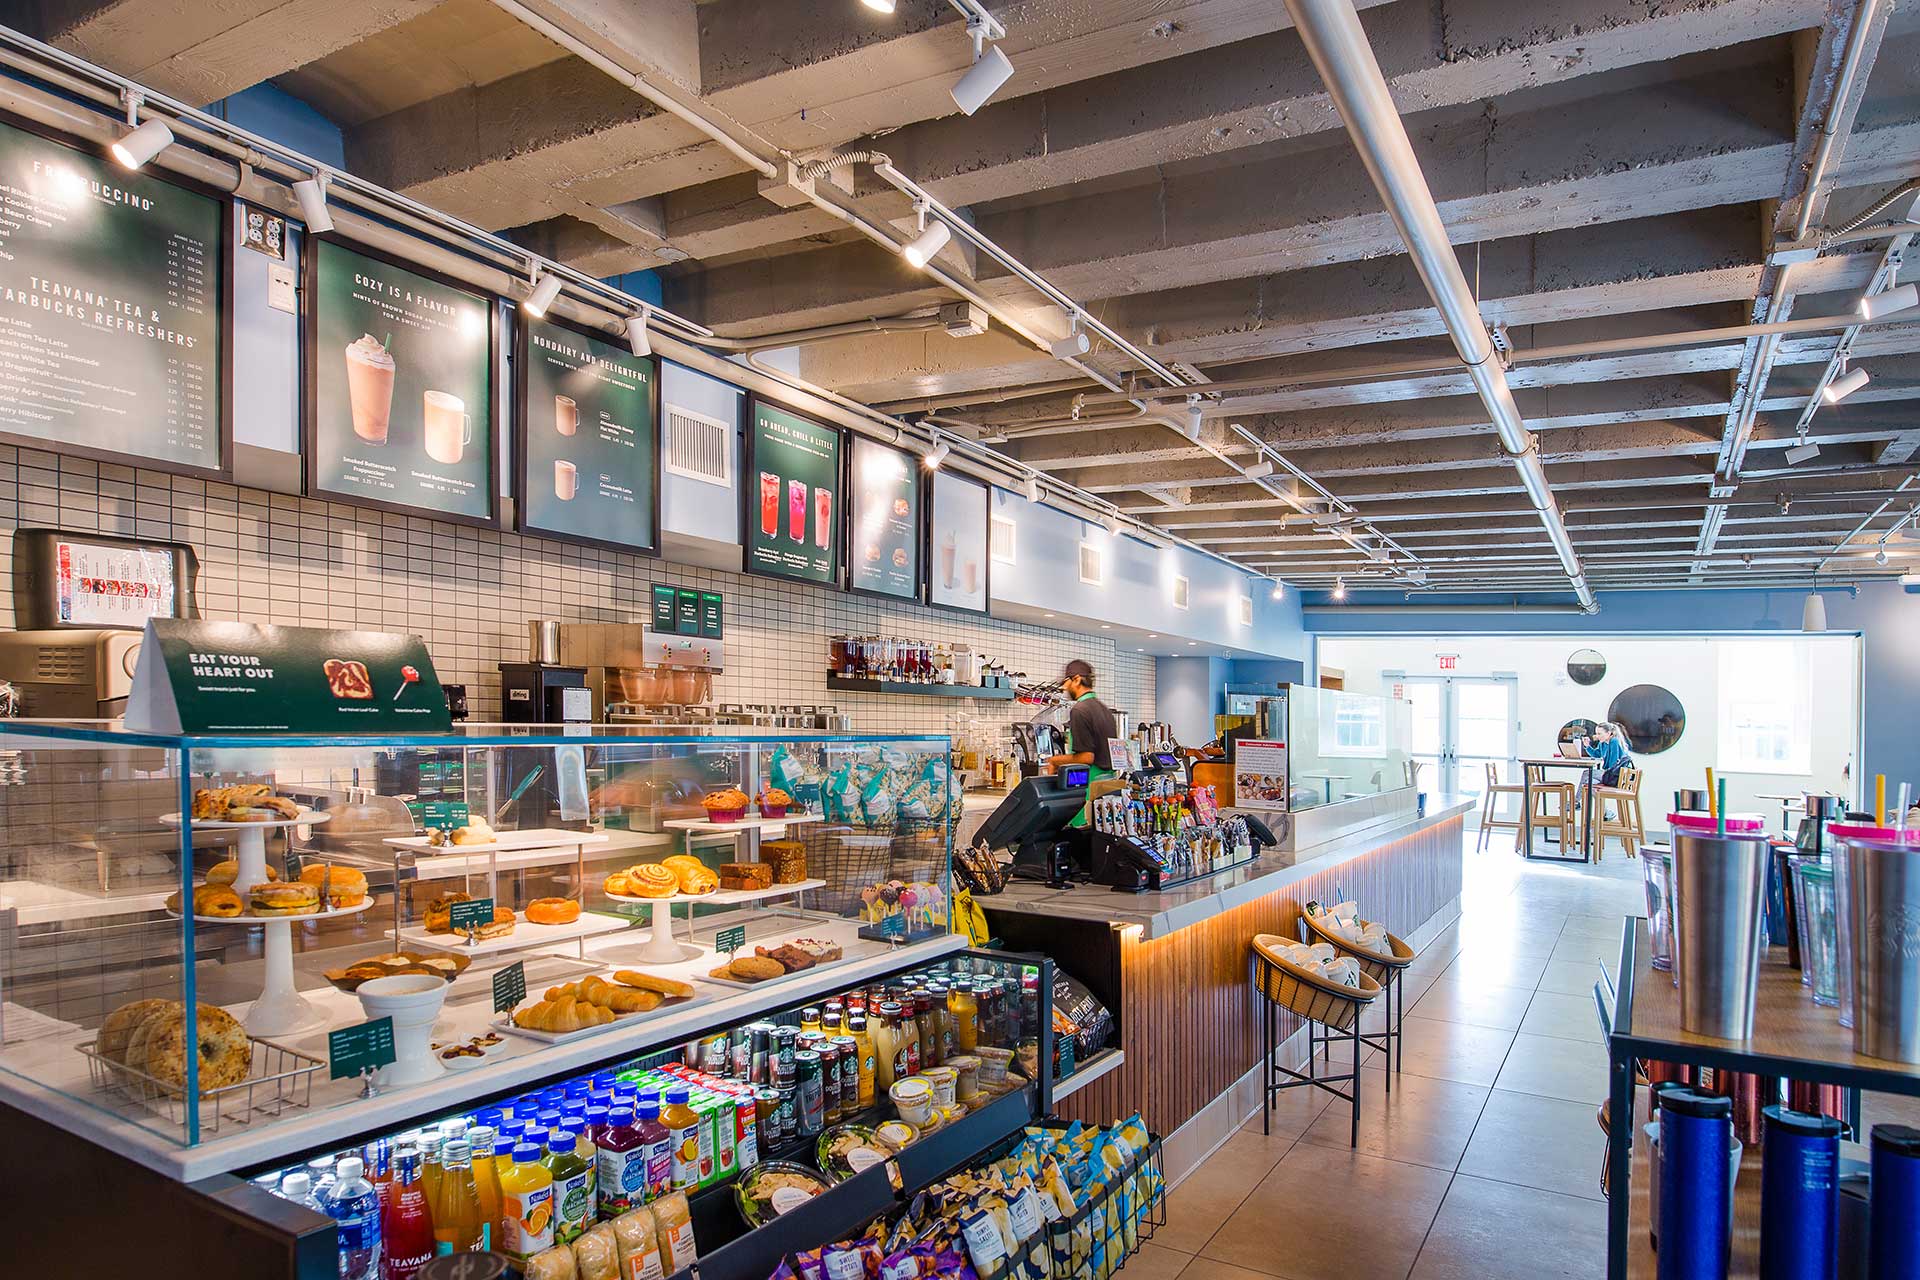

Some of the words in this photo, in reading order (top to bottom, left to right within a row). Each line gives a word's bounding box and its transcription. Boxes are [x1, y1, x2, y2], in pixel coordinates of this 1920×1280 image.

[34, 161, 154, 212] FRPUCCINO
[5, 196, 33, 211] Cookie
[34, 205, 67, 222] Crumble
[5, 207, 26, 221] Bean
[30, 276, 108, 308] TEAVANA
[114, 299, 143, 319] TEA
[151, 310, 160, 324] &
[355, 273, 384, 292] COZY
[389, 286, 401, 299] IS
[405, 292, 412, 302] A
[416, 295, 457, 317] FLAVOR
[0, 286, 86, 320] ARBUCKS
[94, 311, 198, 348] REFRESHERS
[381, 303, 404, 315] BROWN
[404, 309, 424, 321] SUGAR
[382, 311, 394, 321] FOR
[401, 318, 421, 328] SWEET
[11, 317, 33, 329] Latte
[8, 328, 33, 341] Green
[34, 334, 47, 344] Tea
[48, 338, 69, 349] Latte
[20, 342, 46, 354] Green
[46, 348, 60, 358] Tea
[60, 352, 100, 367] Lemonade
[20, 353, 46, 365] White
[47, 360, 60, 369] Tea
[533, 335, 577, 358] NONDAIRY
[580, 352, 596, 366] AND
[600, 359, 648, 383] DELIGHTFUL
[760, 418, 768, 429] GO
[793, 430, 809, 443] CHILL
[815, 437, 833, 451] LITTLE
[189, 653, 216, 665] EAT
[219, 655, 261, 666] YOUR
[1440, 657, 1456, 669] EXIT
[192, 666, 241, 678] HEART
[244, 668, 274, 679] OUT
[626, 1150, 643, 1162] Naked
[567, 1176, 586, 1189] Naked
[531, 1189, 551, 1203] Naked
[976, 1224, 990, 1237] SIMPLY
[978, 1231, 995, 1244] SALTED
[389, 1252, 433, 1268] TEAVANA
[839, 1253, 856, 1266] SWEET
[840, 1261, 858, 1274] POTATO
